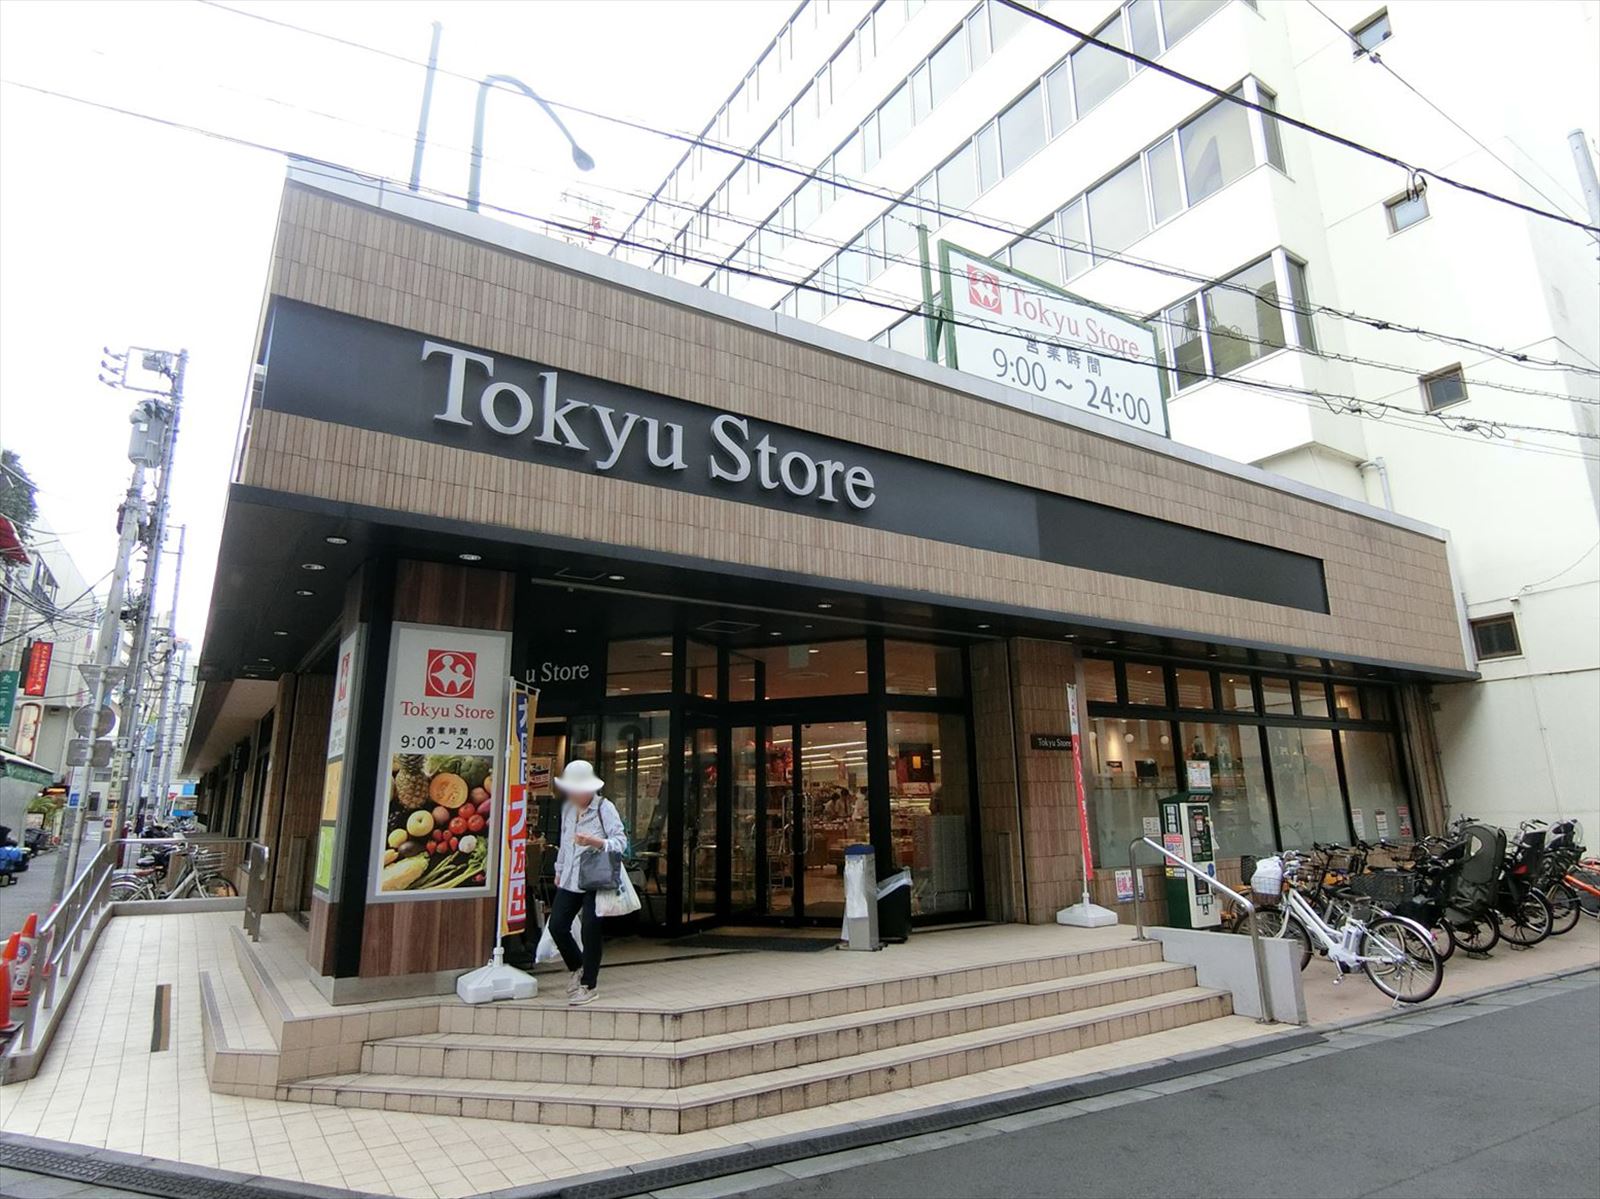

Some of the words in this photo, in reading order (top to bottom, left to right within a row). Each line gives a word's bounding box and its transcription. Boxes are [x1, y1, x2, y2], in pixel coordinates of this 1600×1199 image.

[1010, 288, 1080, 337] Tokyu
[1085, 318, 1140, 359] Store
[1025, 333, 1102, 377] 営業時間
[992, 347, 1047, 391] 9:00
[1084, 379, 1150, 425] 24:00
[421, 340, 688, 470] Tokyu
[709, 414, 877, 510] Store
[541, 662, 590, 681] Store
[400, 701, 450, 720] Tokyu
[454, 704, 495, 719] Store
[401, 735, 436, 749] 9:00
[456, 737, 495, 750] 24:00
